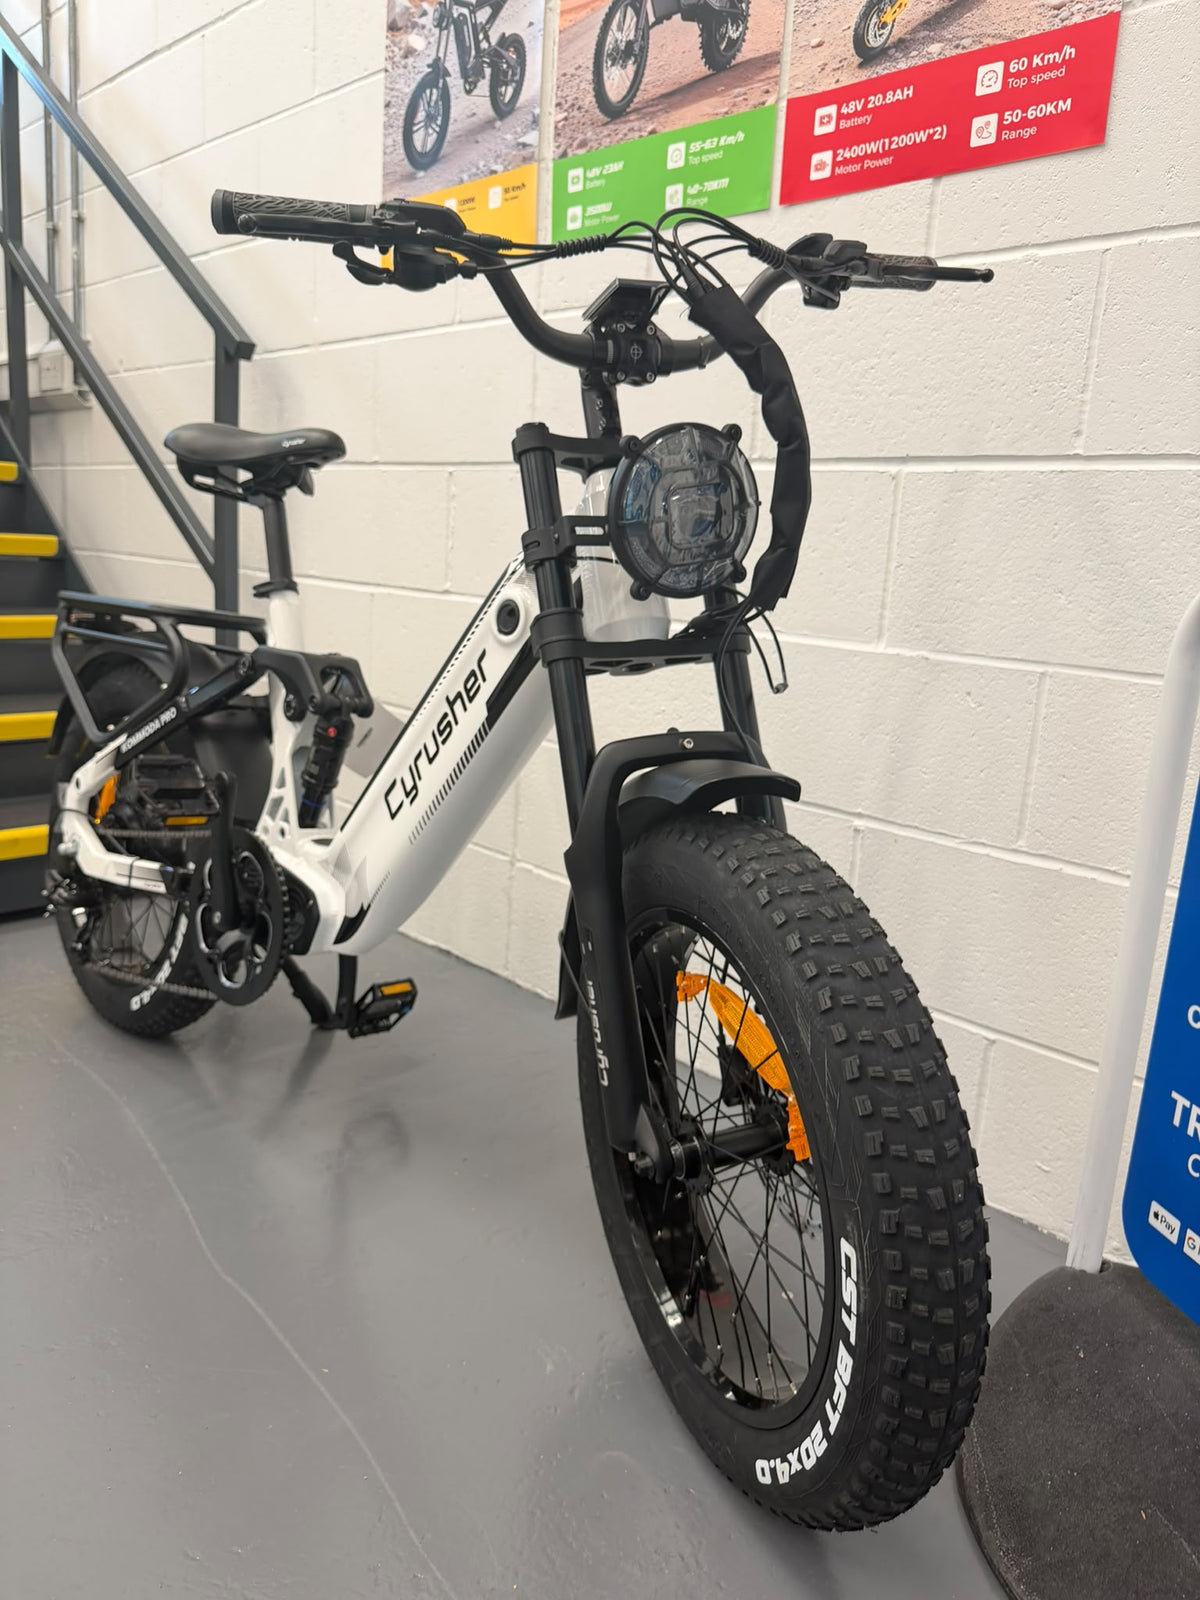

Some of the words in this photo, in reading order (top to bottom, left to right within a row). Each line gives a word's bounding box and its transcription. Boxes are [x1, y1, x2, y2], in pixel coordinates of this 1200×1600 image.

[1009, 57, 1028, 73] 60
[1032, 44, 1076, 68] Km/h
[1007, 76, 1028, 89] Top
[1030, 65, 1066, 85] speed
[840, 98, 865, 115] 48V
[866, 85, 914, 109] 20.8AH
[1002, 97, 1072, 125] 50-60KM
[839, 114, 873, 130] Battery
[1001, 126, 1038, 142] Range
[834, 163, 861, 176] Motor
[863, 156, 894, 170] Power
[159, 706, 177, 727] PRO
[384, 648, 486, 820] Cyrusher
[1160, 1214, 1176, 1235] Pay
[840, 1236, 858, 1346] CST
[825, 1338, 854, 1436] BFT
